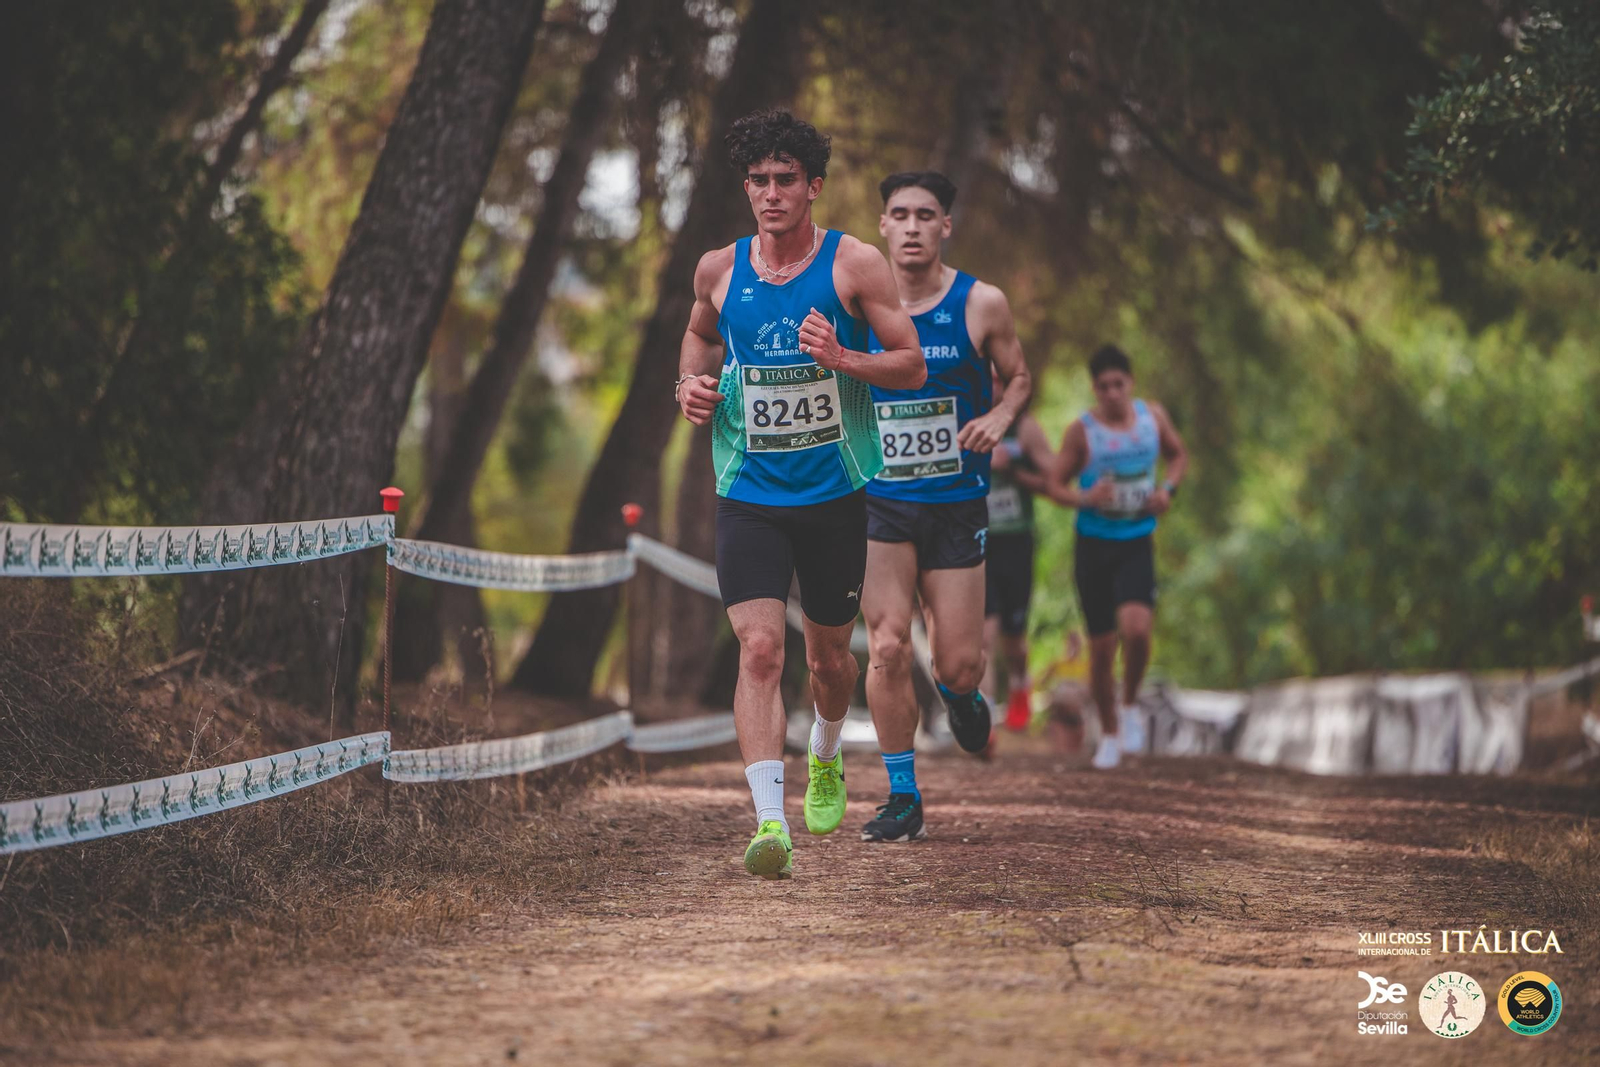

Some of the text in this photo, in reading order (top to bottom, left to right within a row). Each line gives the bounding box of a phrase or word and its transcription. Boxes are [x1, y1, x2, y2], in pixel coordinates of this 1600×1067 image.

[921, 345, 959, 359] ERRA
[765, 368, 811, 380] ITÁLICA
[753, 394, 834, 428] 8243
[883, 427, 952, 458] 8289
